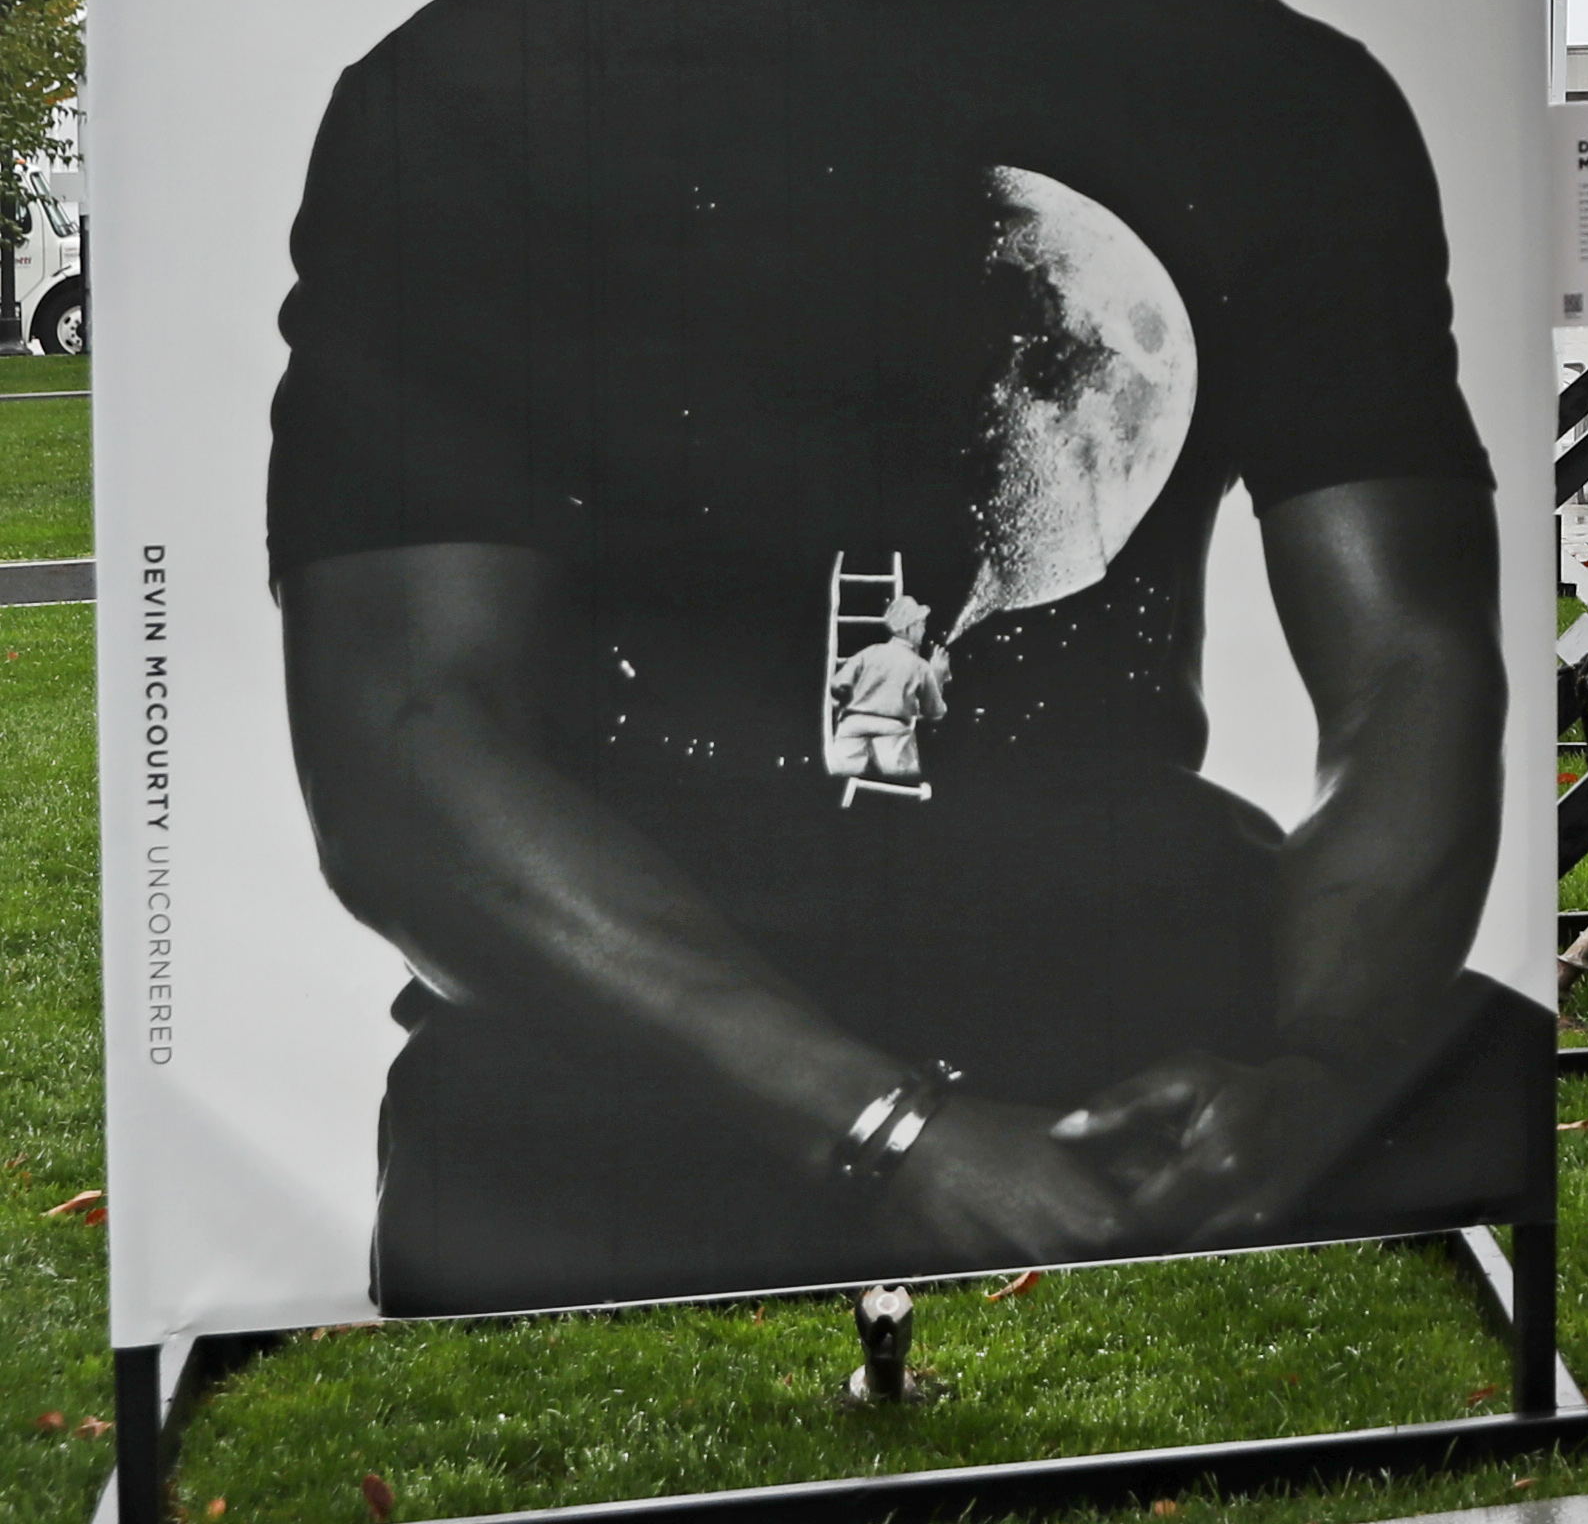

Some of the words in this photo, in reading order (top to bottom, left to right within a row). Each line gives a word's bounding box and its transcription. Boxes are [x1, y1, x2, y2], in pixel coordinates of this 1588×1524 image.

[143, 543, 166, 642] DEVIN
[146, 655, 169, 832] MCCOURTY
[148, 846, 172, 1066] UNCORNERED
